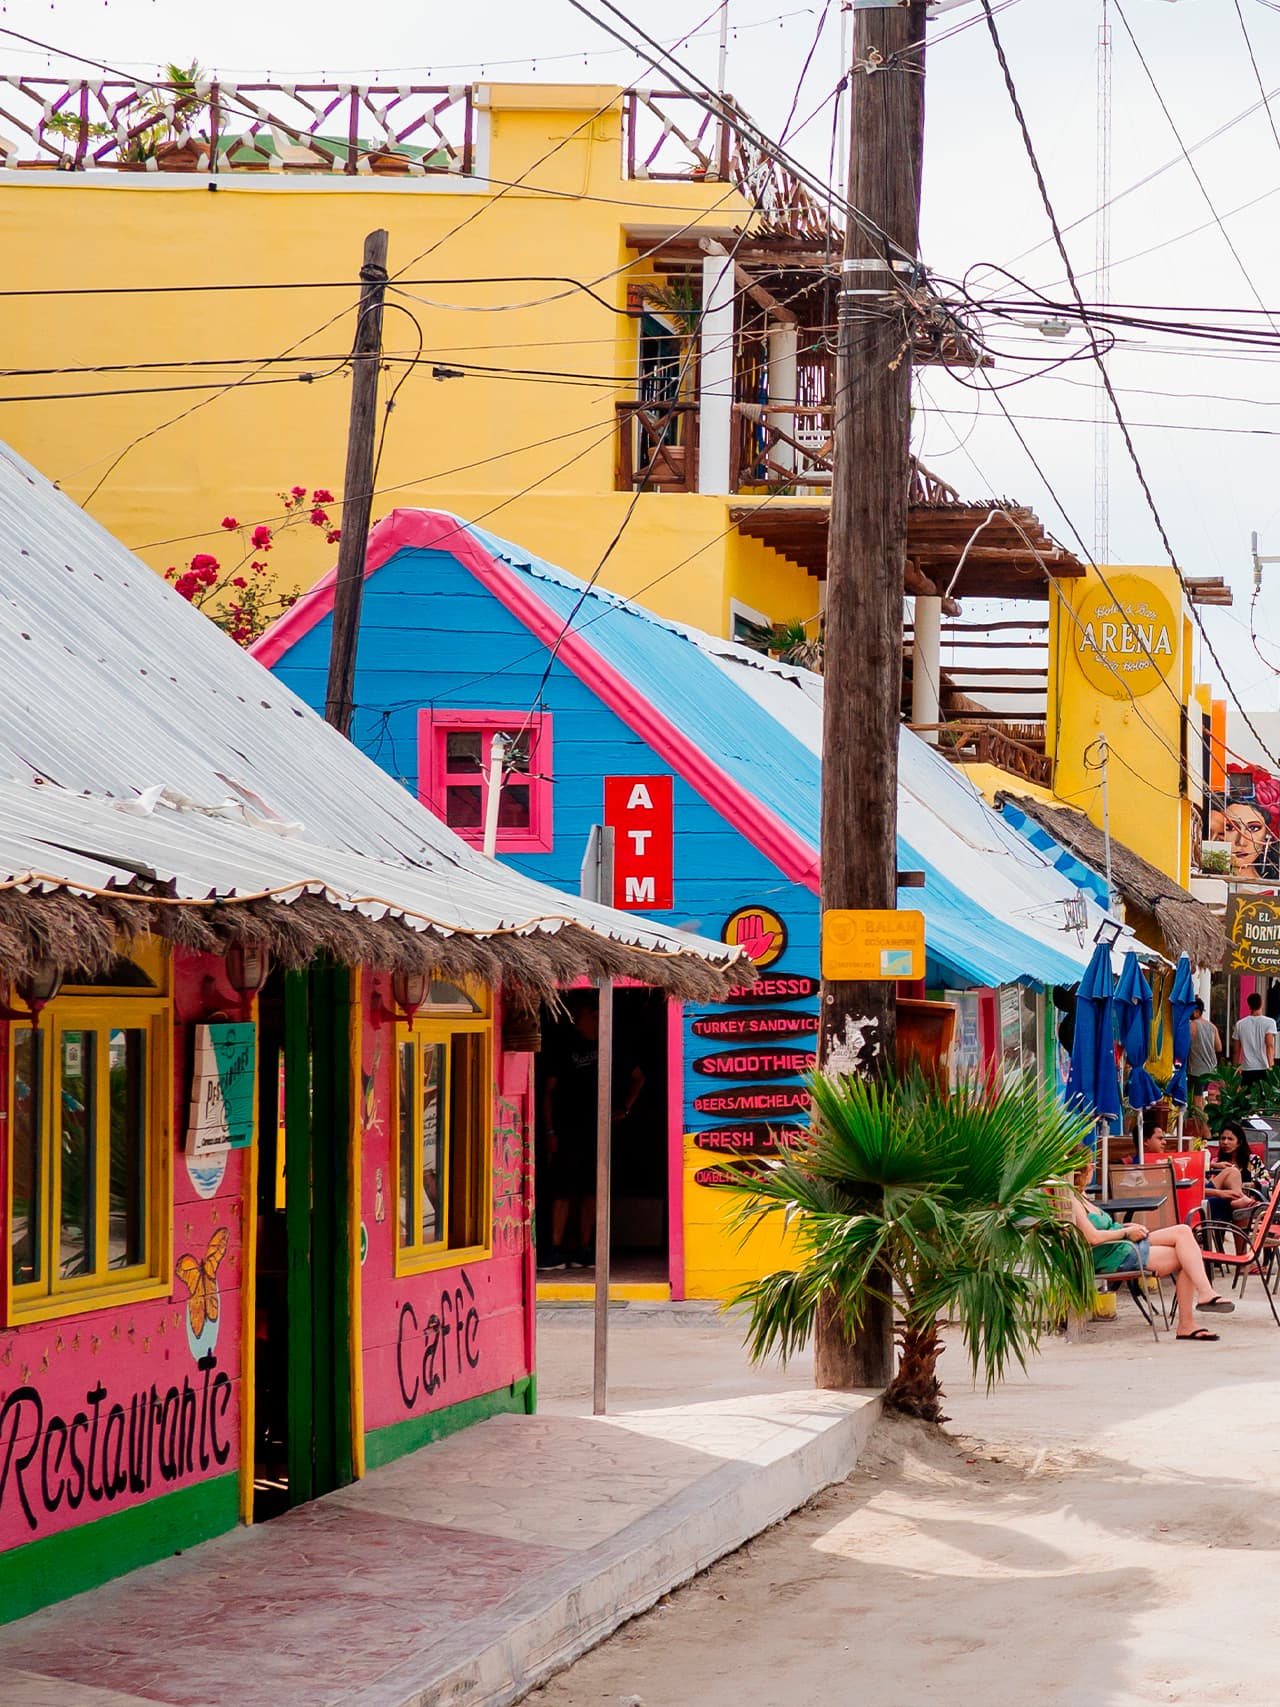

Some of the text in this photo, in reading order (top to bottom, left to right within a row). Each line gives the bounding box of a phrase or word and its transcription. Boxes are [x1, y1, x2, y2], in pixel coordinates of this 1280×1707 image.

[1080, 622, 1172, 655] ARENA
[625, 783, 655, 902] ATM
[1258, 912, 1271, 922] EL
[728, 979, 811, 997] SPRESSO
[695, 1020, 746, 1034] TURKEY
[702, 1054, 817, 1073] SMOOTHIES
[694, 1093, 811, 1111] BEERS/MICHELAD
[698, 1131, 755, 1148] FRESH
[0, 1347, 232, 1531] Restaurante
